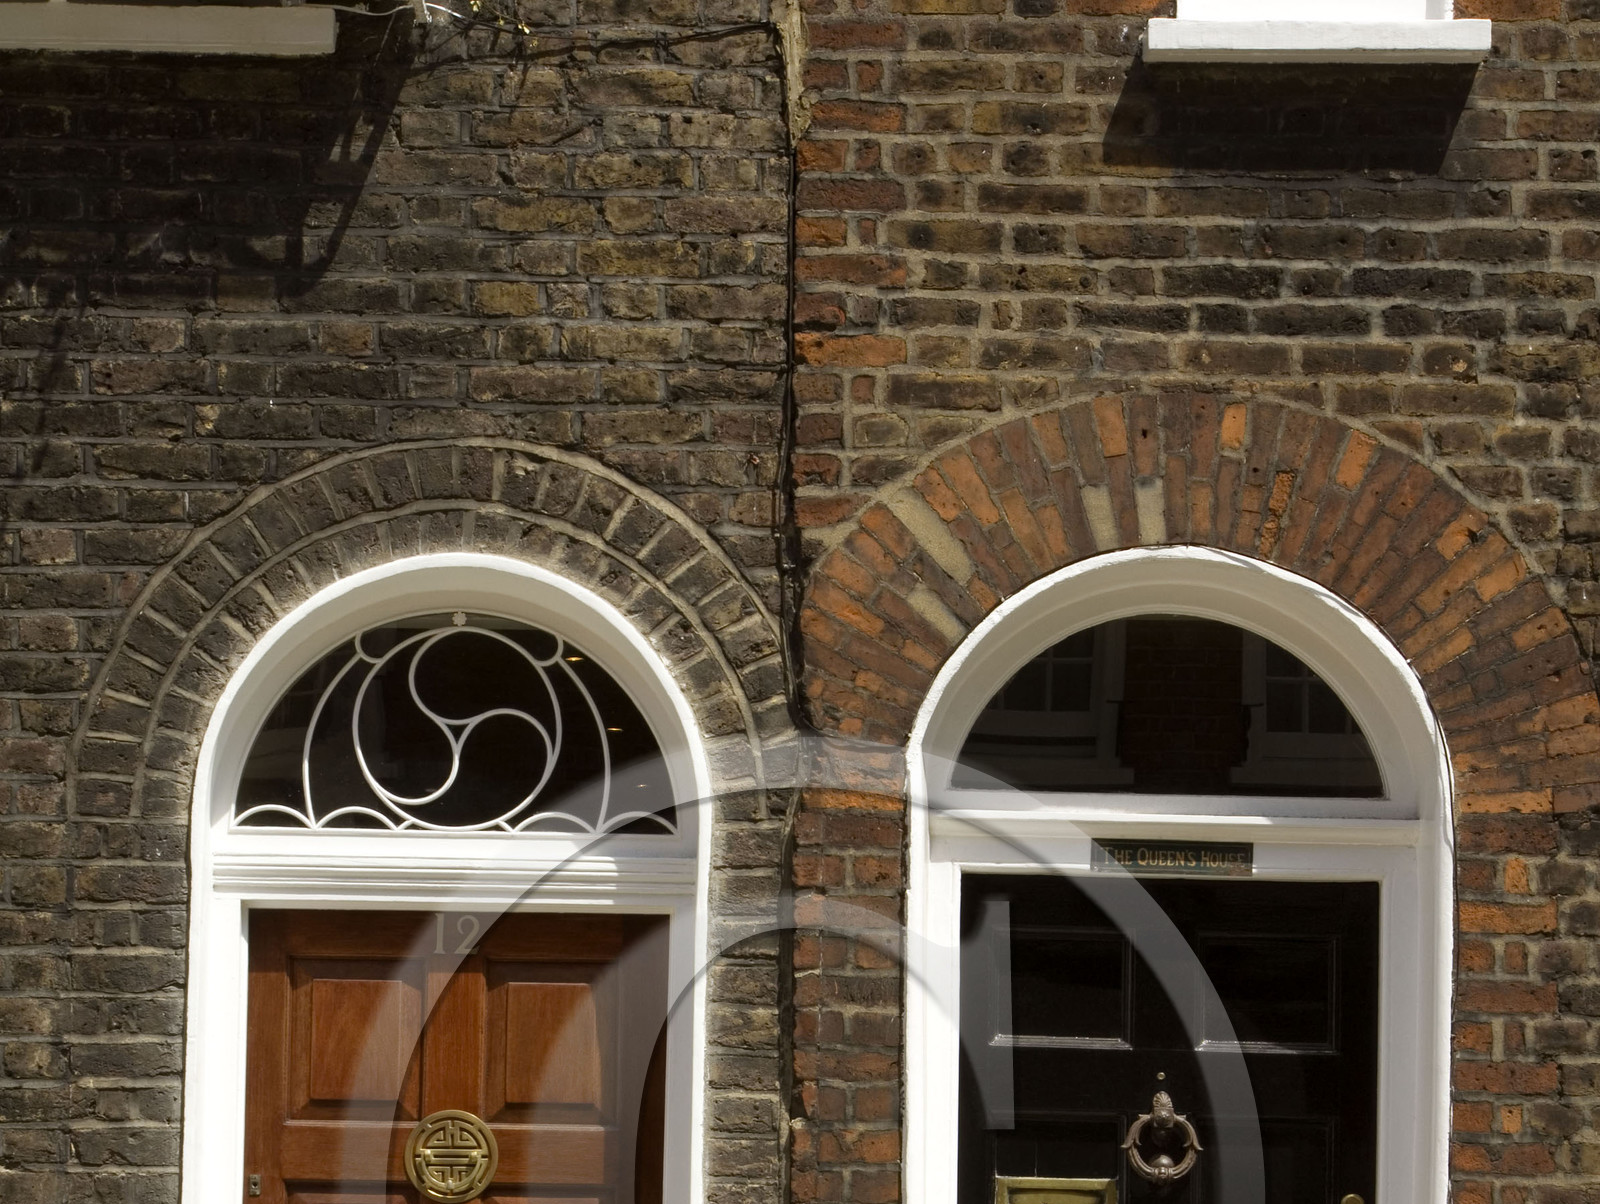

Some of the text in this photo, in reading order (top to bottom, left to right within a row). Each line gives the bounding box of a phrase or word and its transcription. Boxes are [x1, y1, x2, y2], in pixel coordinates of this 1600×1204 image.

[1102, 847, 1246, 868] THE QUEEN'S HOUSE
[433, 913, 480, 954] 12
